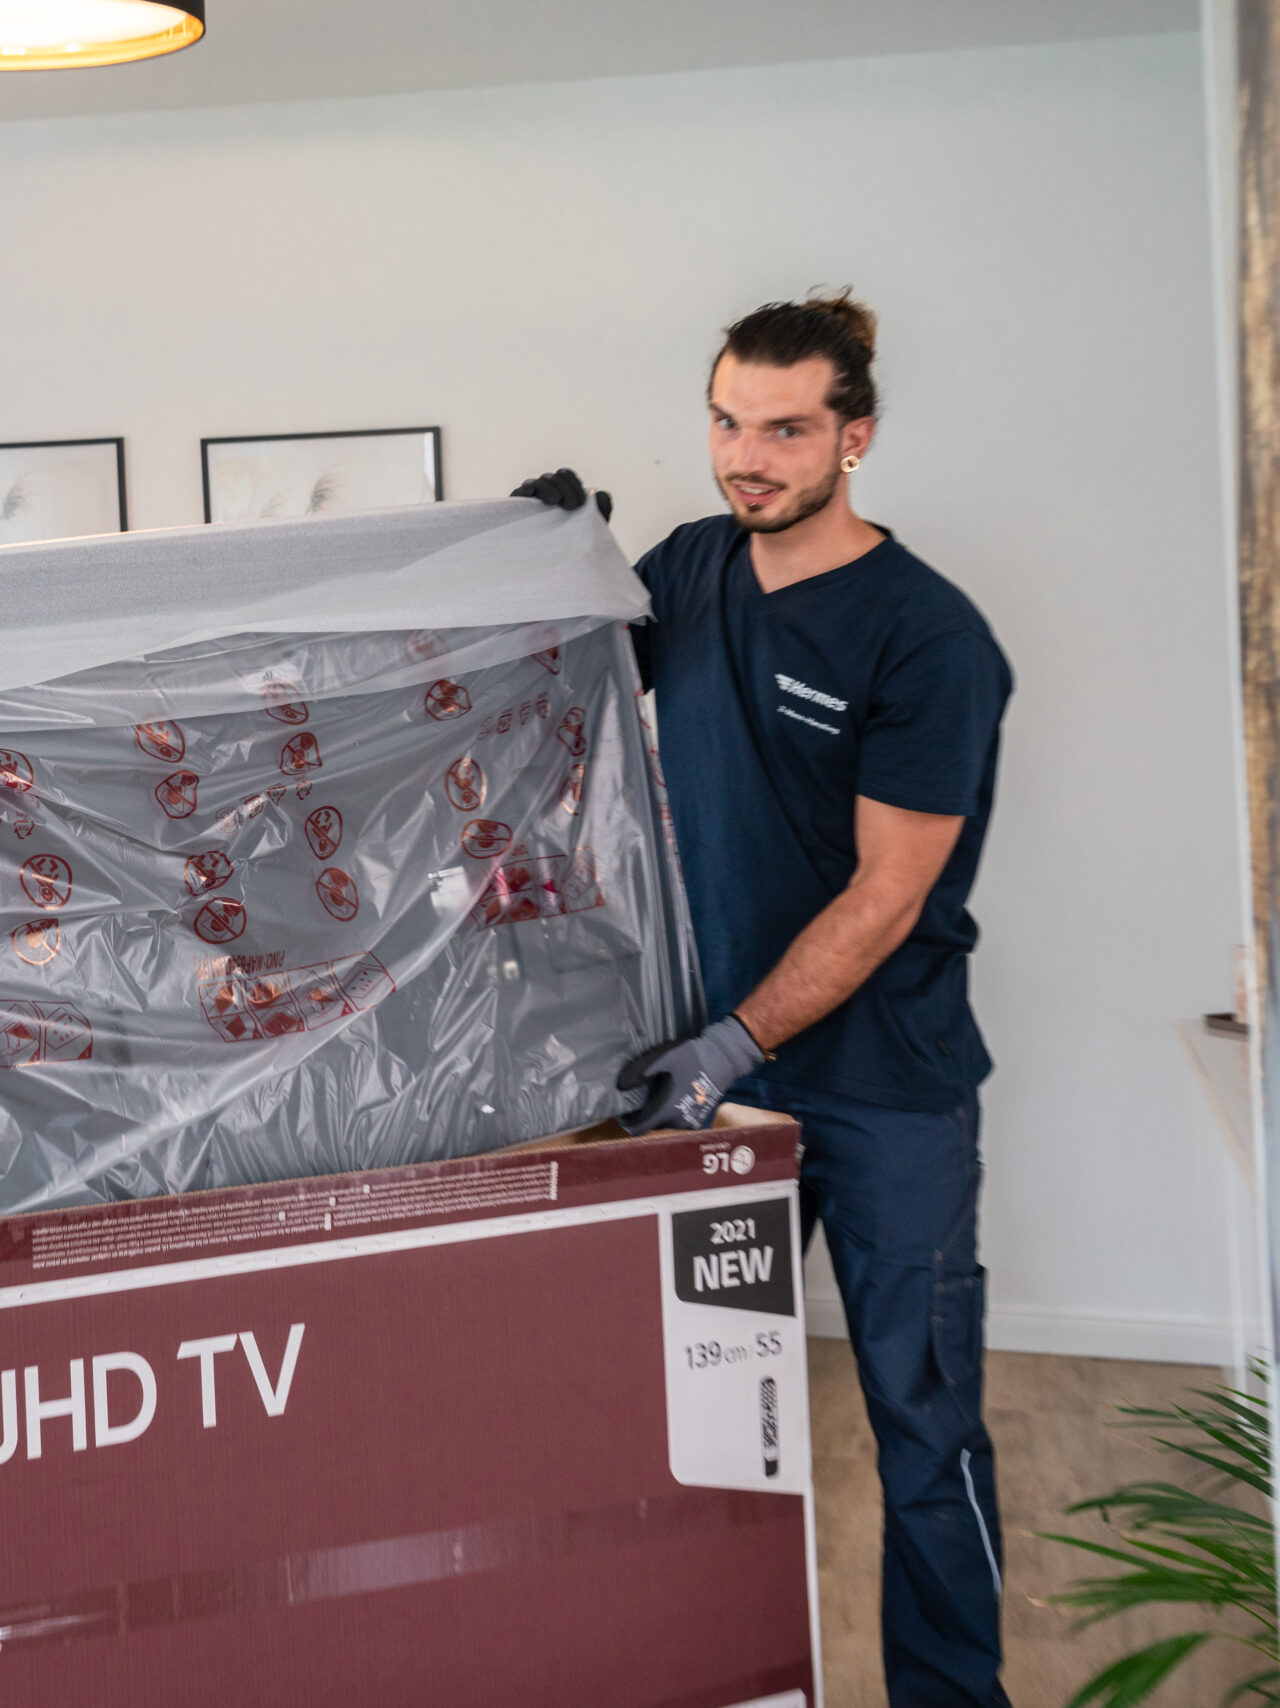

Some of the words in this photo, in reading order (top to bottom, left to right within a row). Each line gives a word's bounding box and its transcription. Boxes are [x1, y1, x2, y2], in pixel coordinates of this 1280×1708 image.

[710, 1217, 756, 1245] 2021
[692, 1245, 774, 1293] NEW
[177, 1323, 306, 1428] TV
